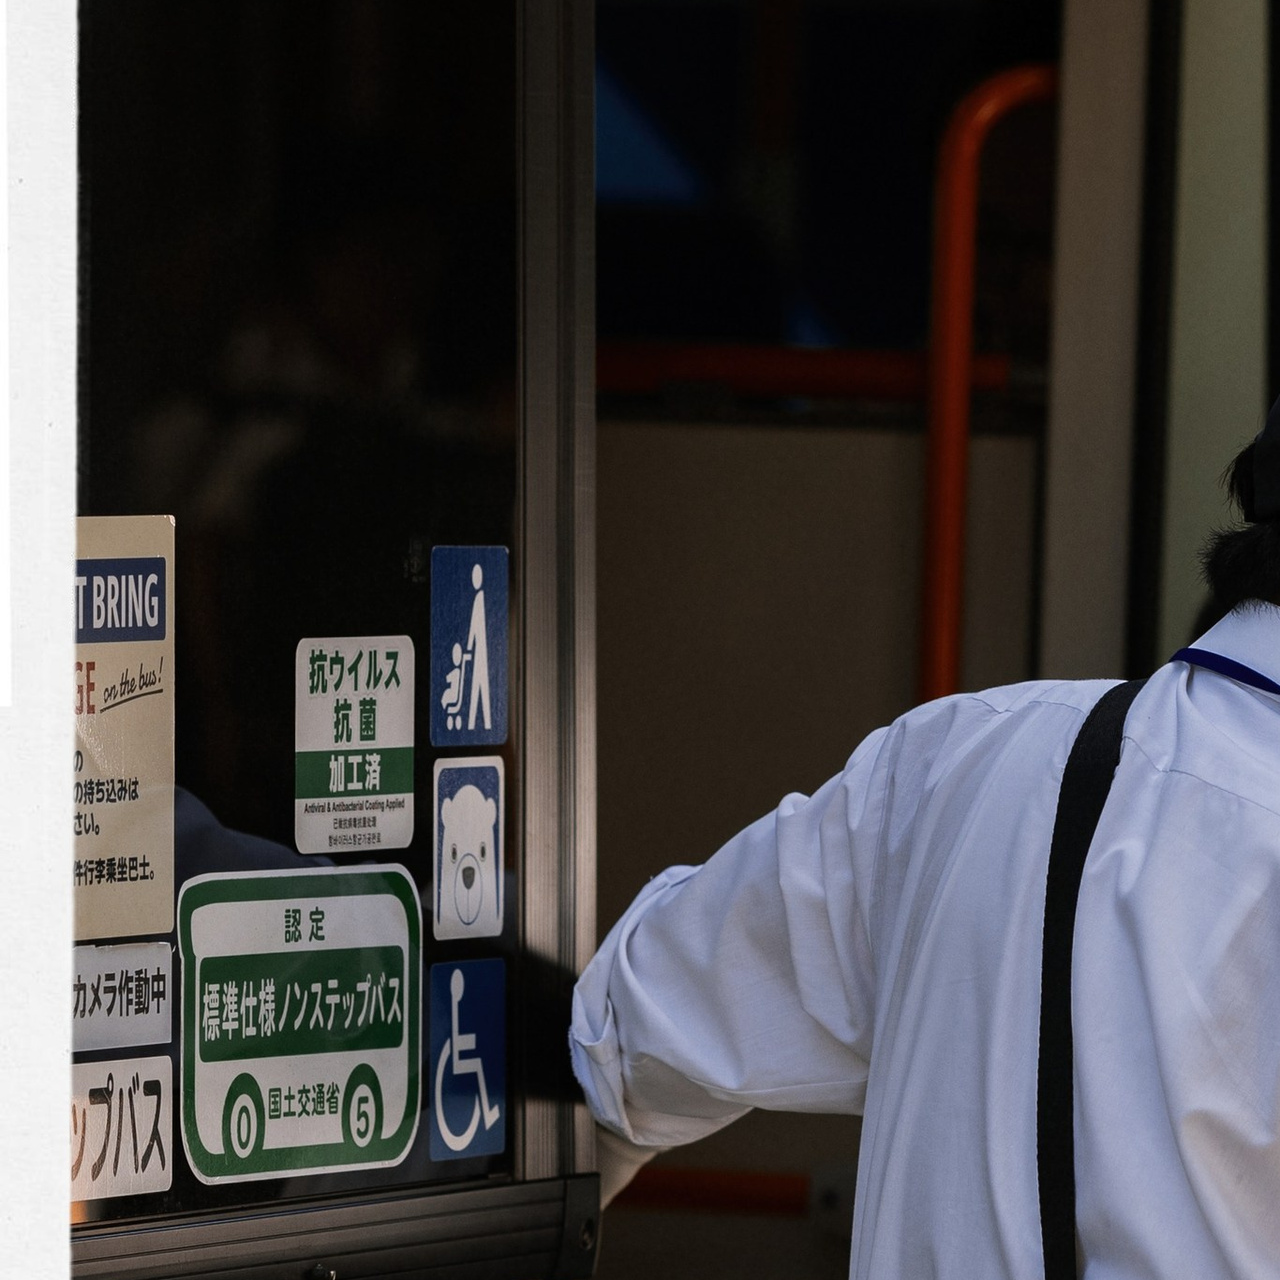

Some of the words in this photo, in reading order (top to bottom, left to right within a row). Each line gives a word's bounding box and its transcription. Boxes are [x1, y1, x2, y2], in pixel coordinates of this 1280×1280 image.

[93, 573, 159, 629] BRING
[103, 684, 119, 704] on
[119, 667, 137, 698] the
[138, 656, 164, 691] bus!
[309, 648, 401, 695] 抗ウイルス
[333, 697, 377, 744] 抗菌
[329, 752, 382, 793] 加工済
[304, 802, 326, 814] Antiviral
[332, 800, 364, 813] Antibacterial
[365, 799, 385, 813] Coating
[385, 797, 405, 812] Applied
[284, 906, 326, 944] 認定
[268, 1081, 340, 1120] 国土交通省
[356, 1095, 370, 1140] 5
